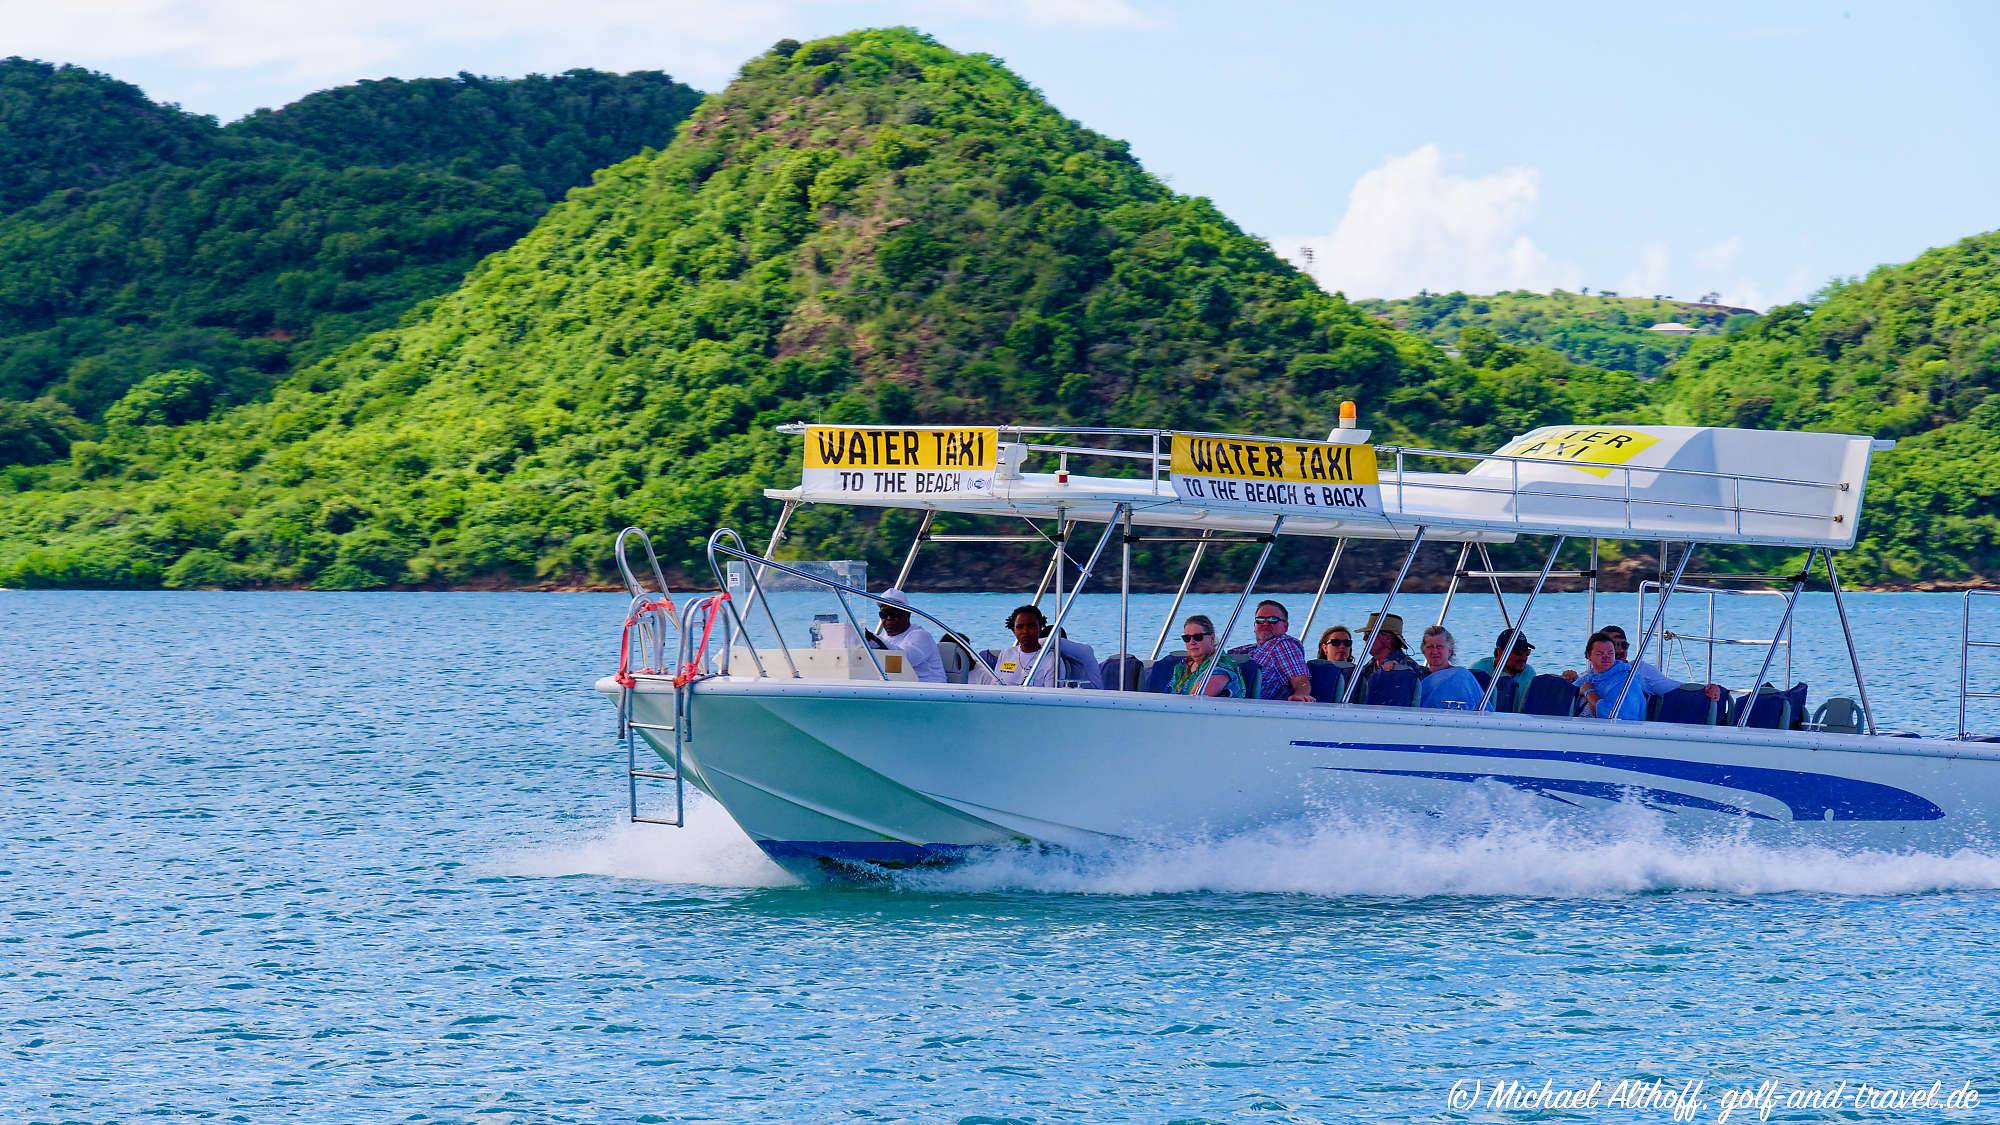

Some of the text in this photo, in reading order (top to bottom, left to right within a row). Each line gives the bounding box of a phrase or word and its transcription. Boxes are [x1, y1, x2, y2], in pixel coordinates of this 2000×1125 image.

[818, 431, 984, 466] WATER TAXI
[1530, 430, 1633, 449] TER
[1190, 438, 1353, 480] WATER TAXI
[840, 472, 961, 493] TO THE BEACH
[1183, 477, 1367, 508] TO THE BEACH & BACK
